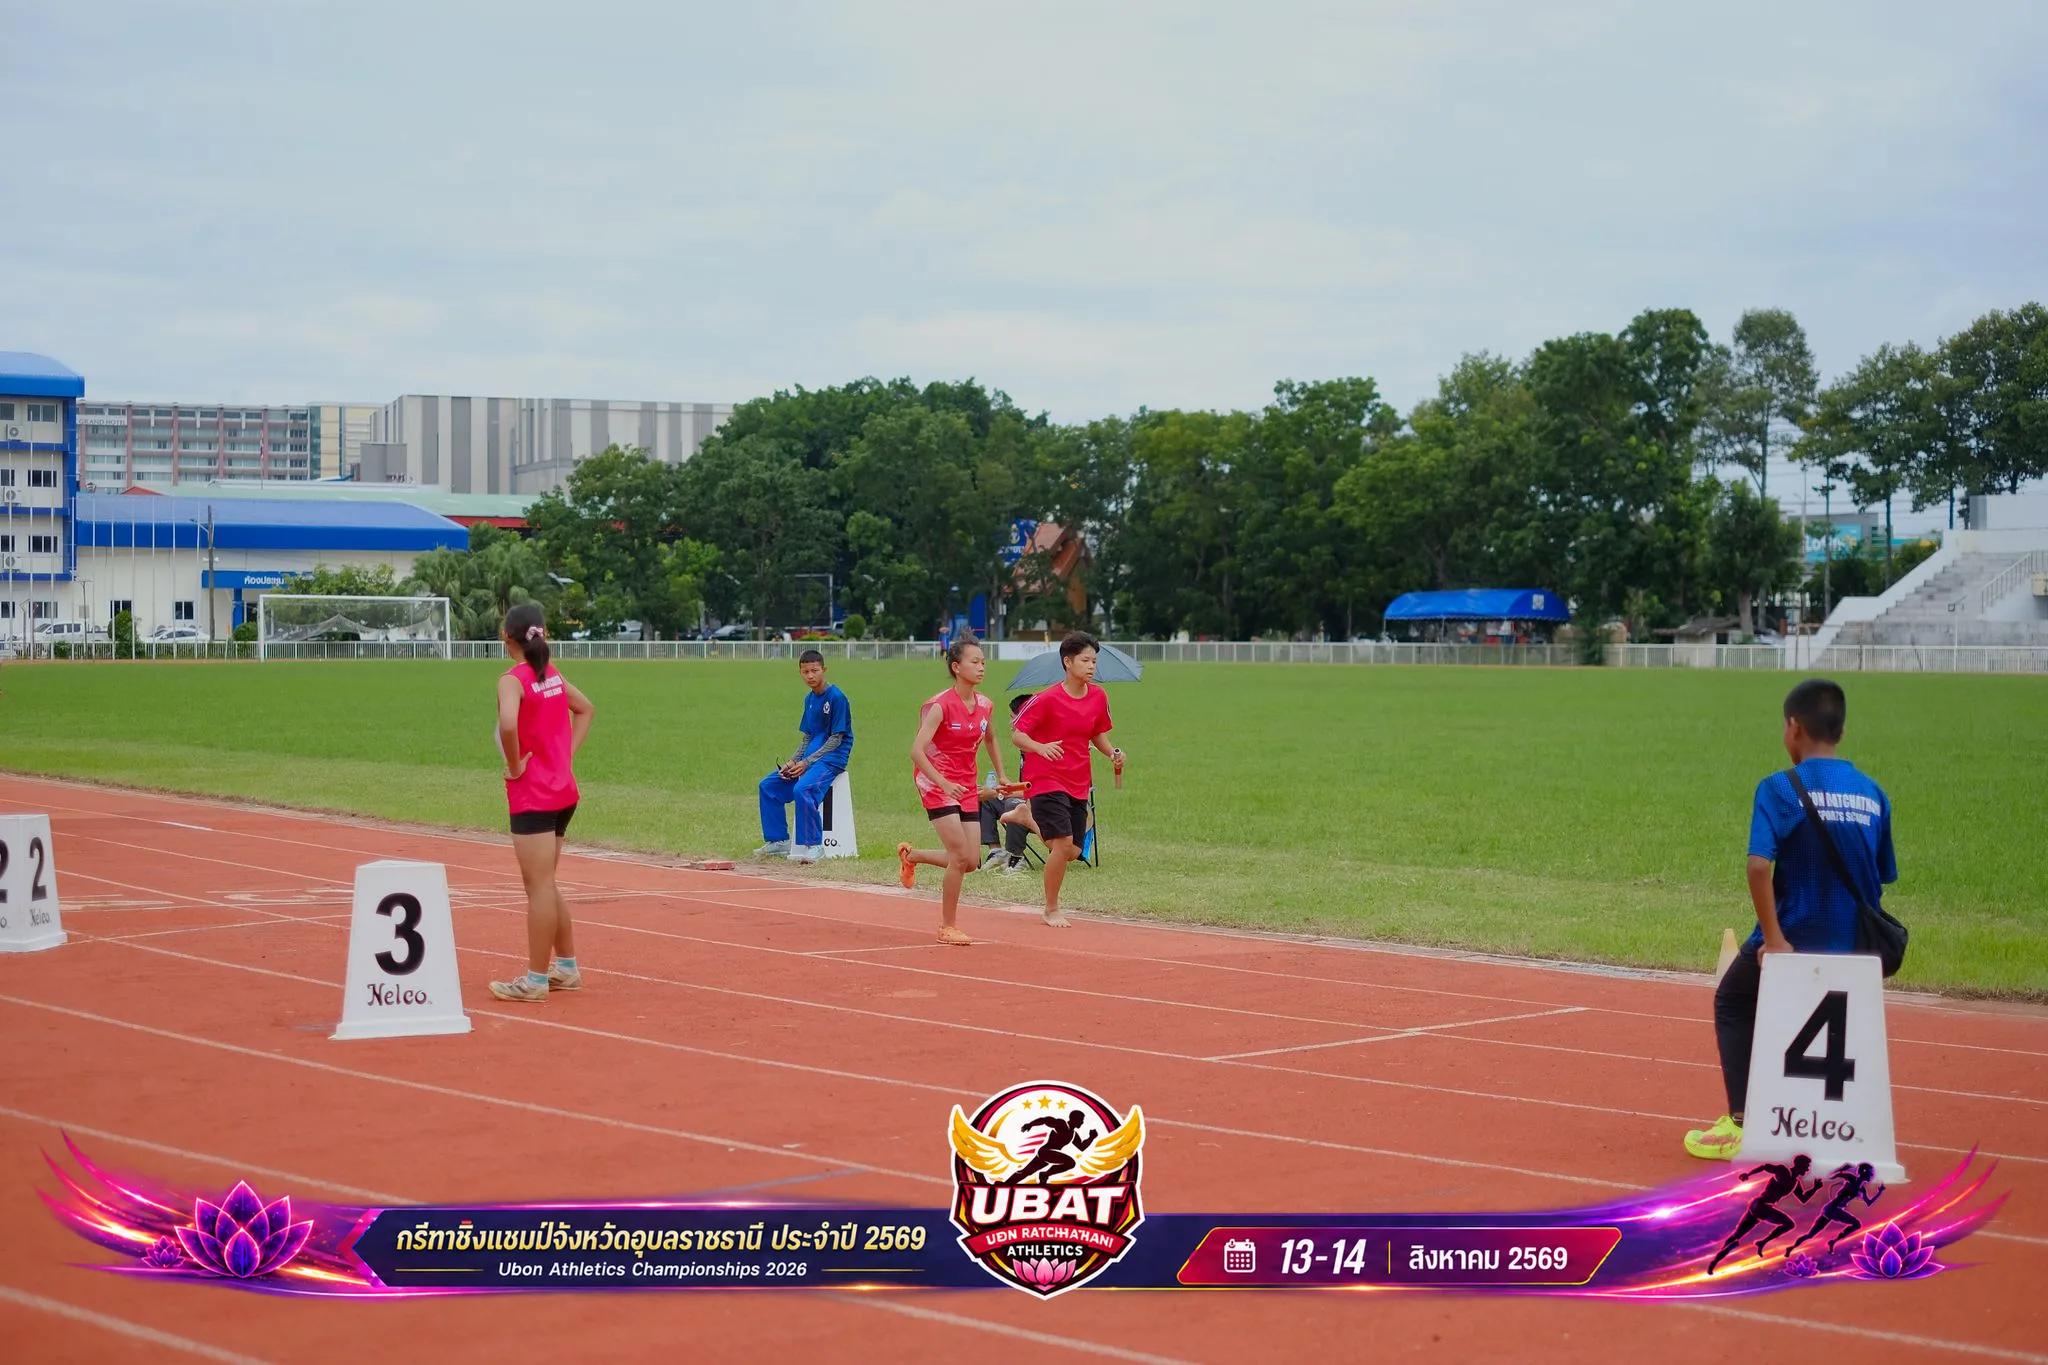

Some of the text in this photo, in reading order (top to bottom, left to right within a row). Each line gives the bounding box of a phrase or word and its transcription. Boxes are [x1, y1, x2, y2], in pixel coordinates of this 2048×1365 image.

[29, 836, 47, 901] 2
[375, 892, 425, 976] 3
[367, 983, 427, 1006] Nelco
[1784, 990, 1855, 1102] 4
[1771, 1106, 1855, 1141] Nelco
